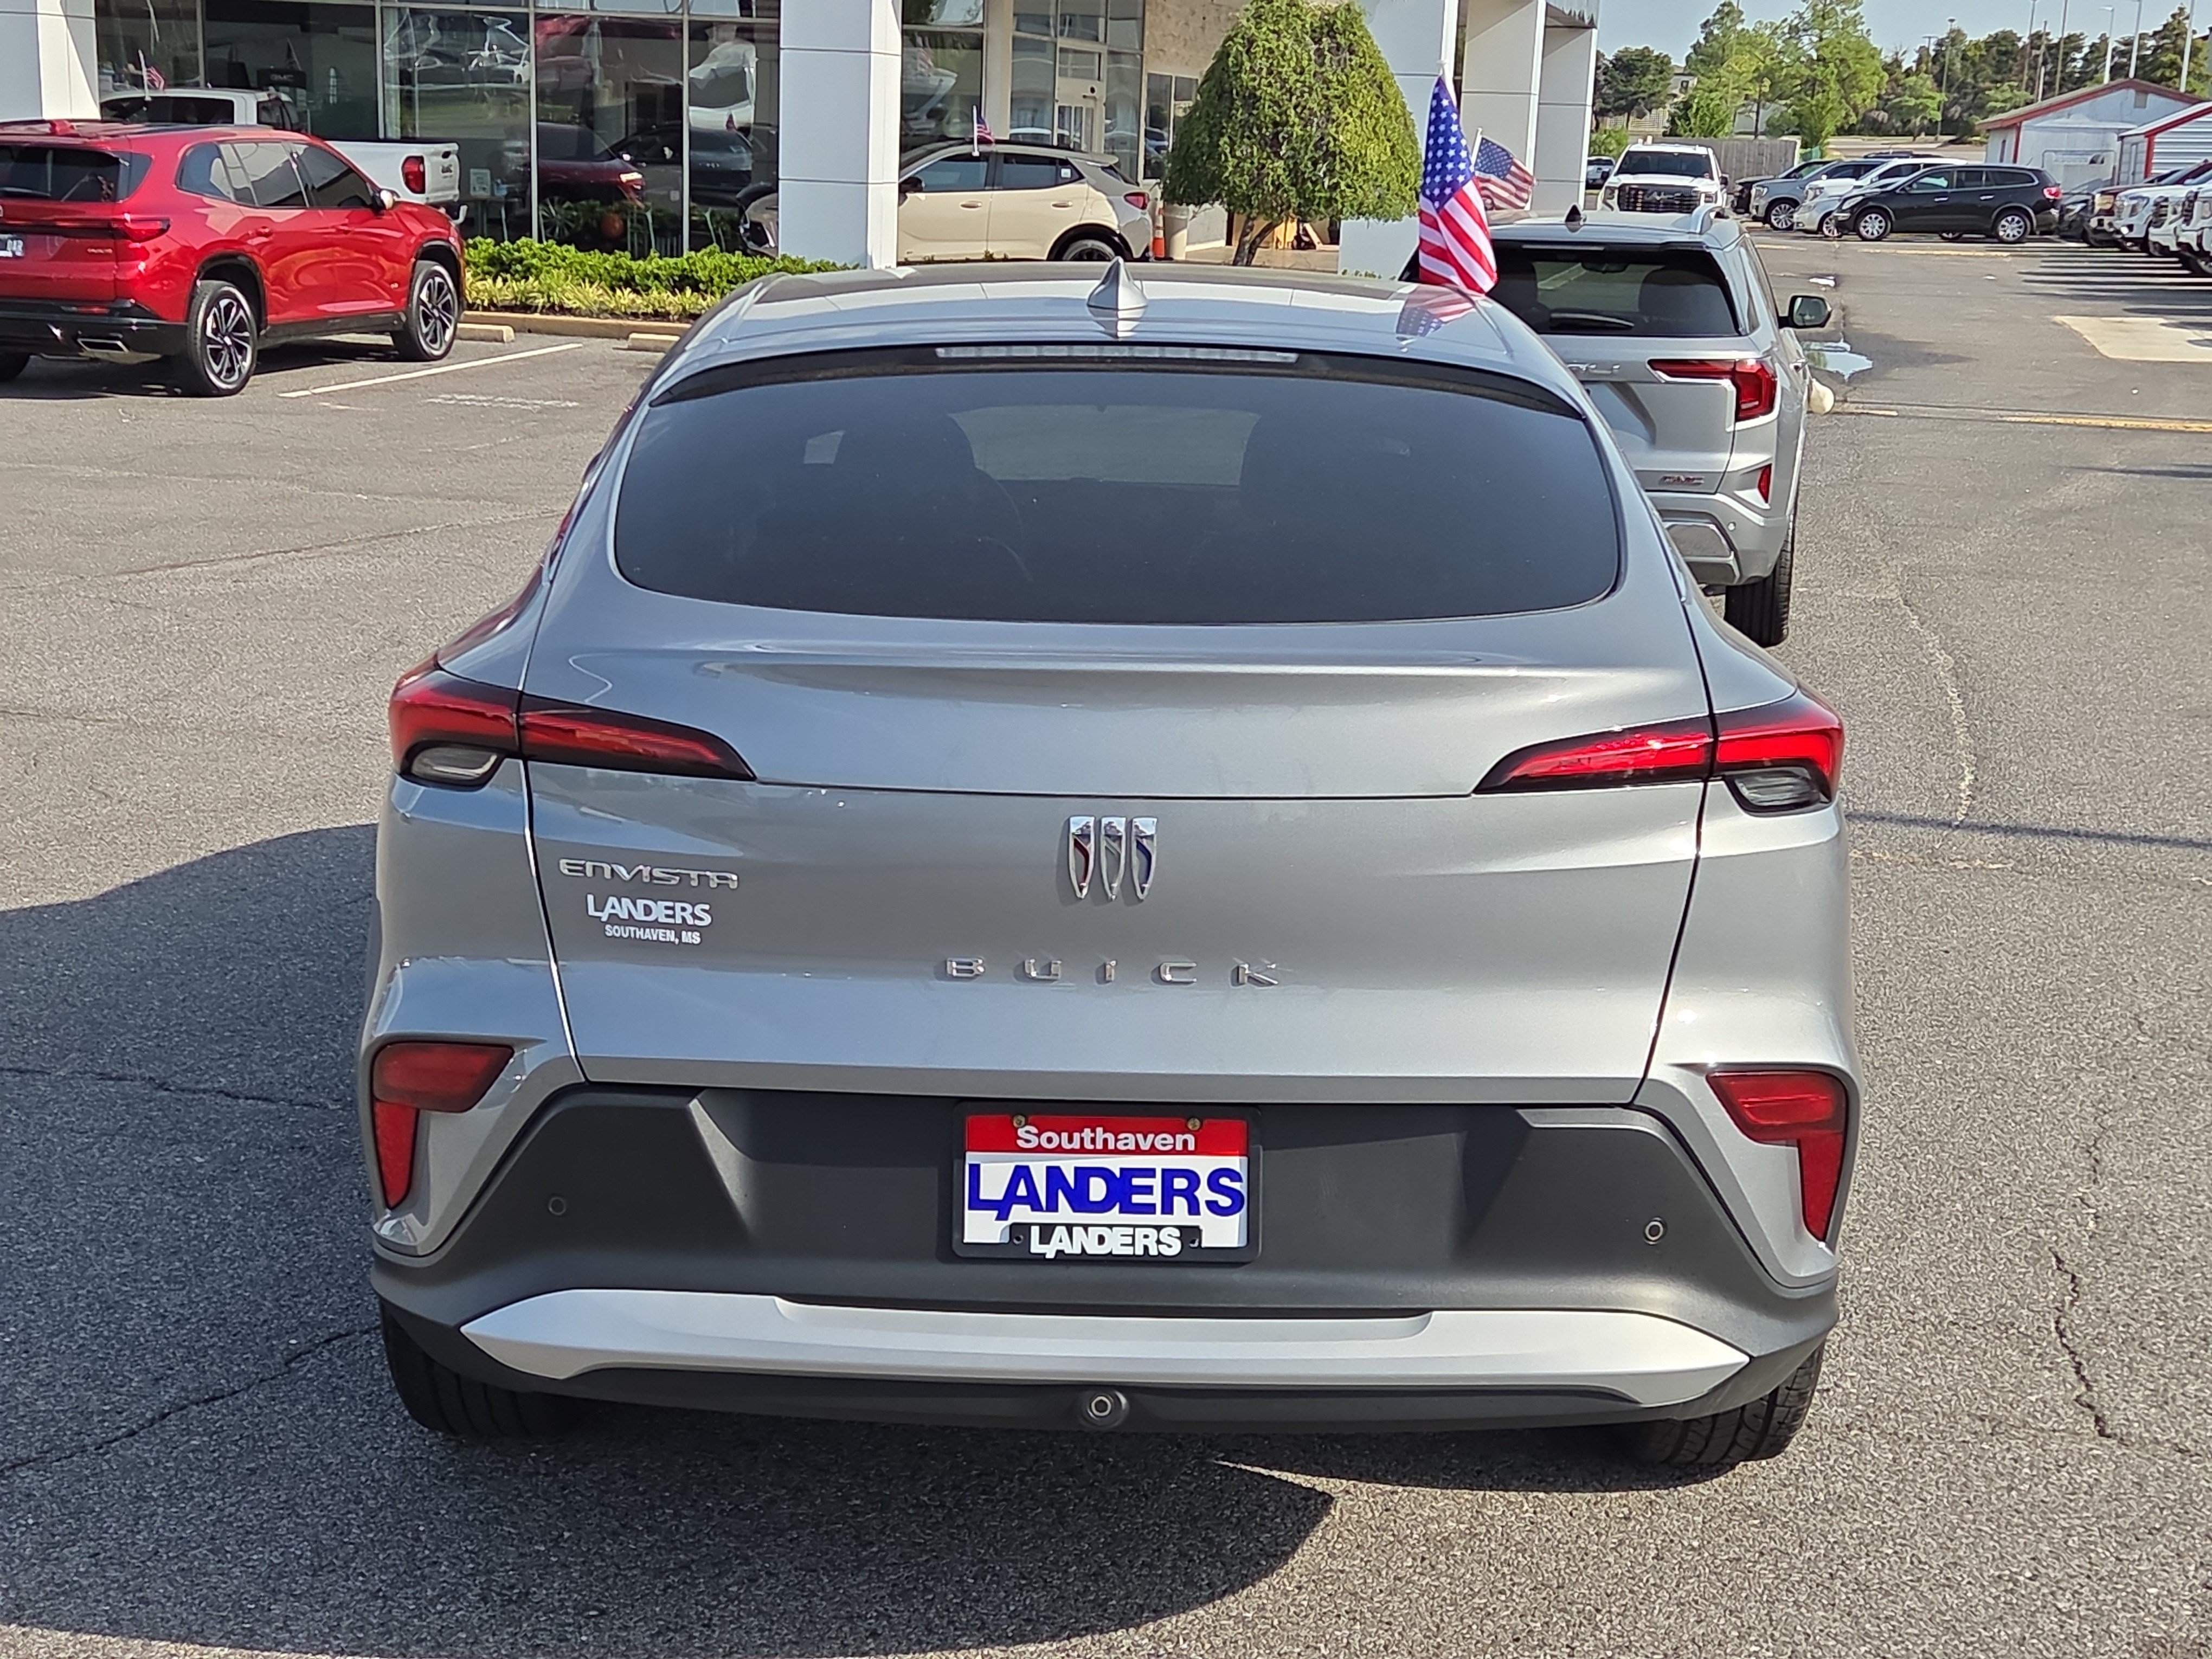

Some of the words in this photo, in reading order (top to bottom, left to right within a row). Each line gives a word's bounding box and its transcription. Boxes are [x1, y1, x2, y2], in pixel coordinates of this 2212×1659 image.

[559, 858, 738, 889] ENVISTA
[586, 894, 712, 927] LANDERS
[605, 924, 678, 944] SOUTHAVEN,
[681, 931, 702, 944] MS
[946, 957, 1279, 986] BUICK
[1016, 1126, 1196, 1151] Southaven
[968, 1163, 1245, 1221] LANDERS
[1030, 1225, 1182, 1259] LANDERS
